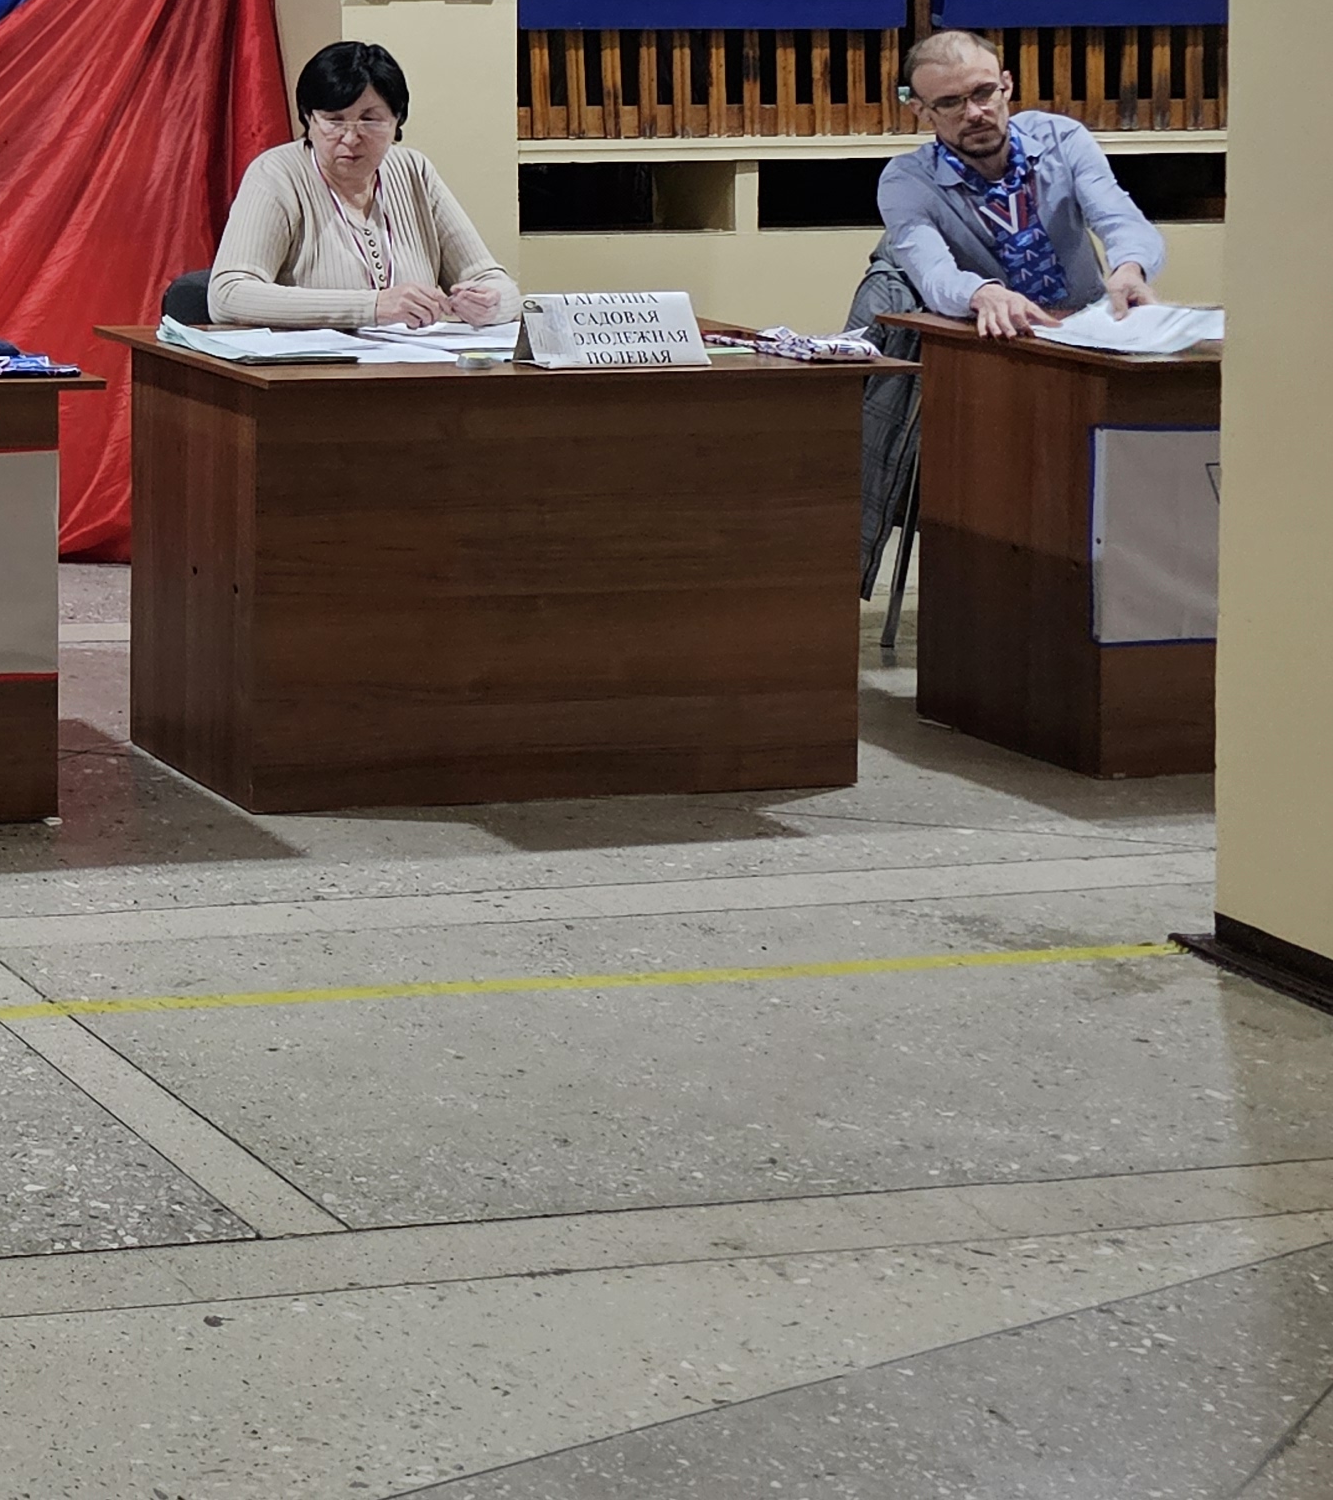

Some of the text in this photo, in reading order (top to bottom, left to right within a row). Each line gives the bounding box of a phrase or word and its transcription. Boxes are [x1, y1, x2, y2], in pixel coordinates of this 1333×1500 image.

[573, 310, 660, 327] САДОВАЯ
[573, 329, 689, 346] ОЛОДЕЖНАЯ
[586, 349, 672, 365] ПОЛЕВАЯ
